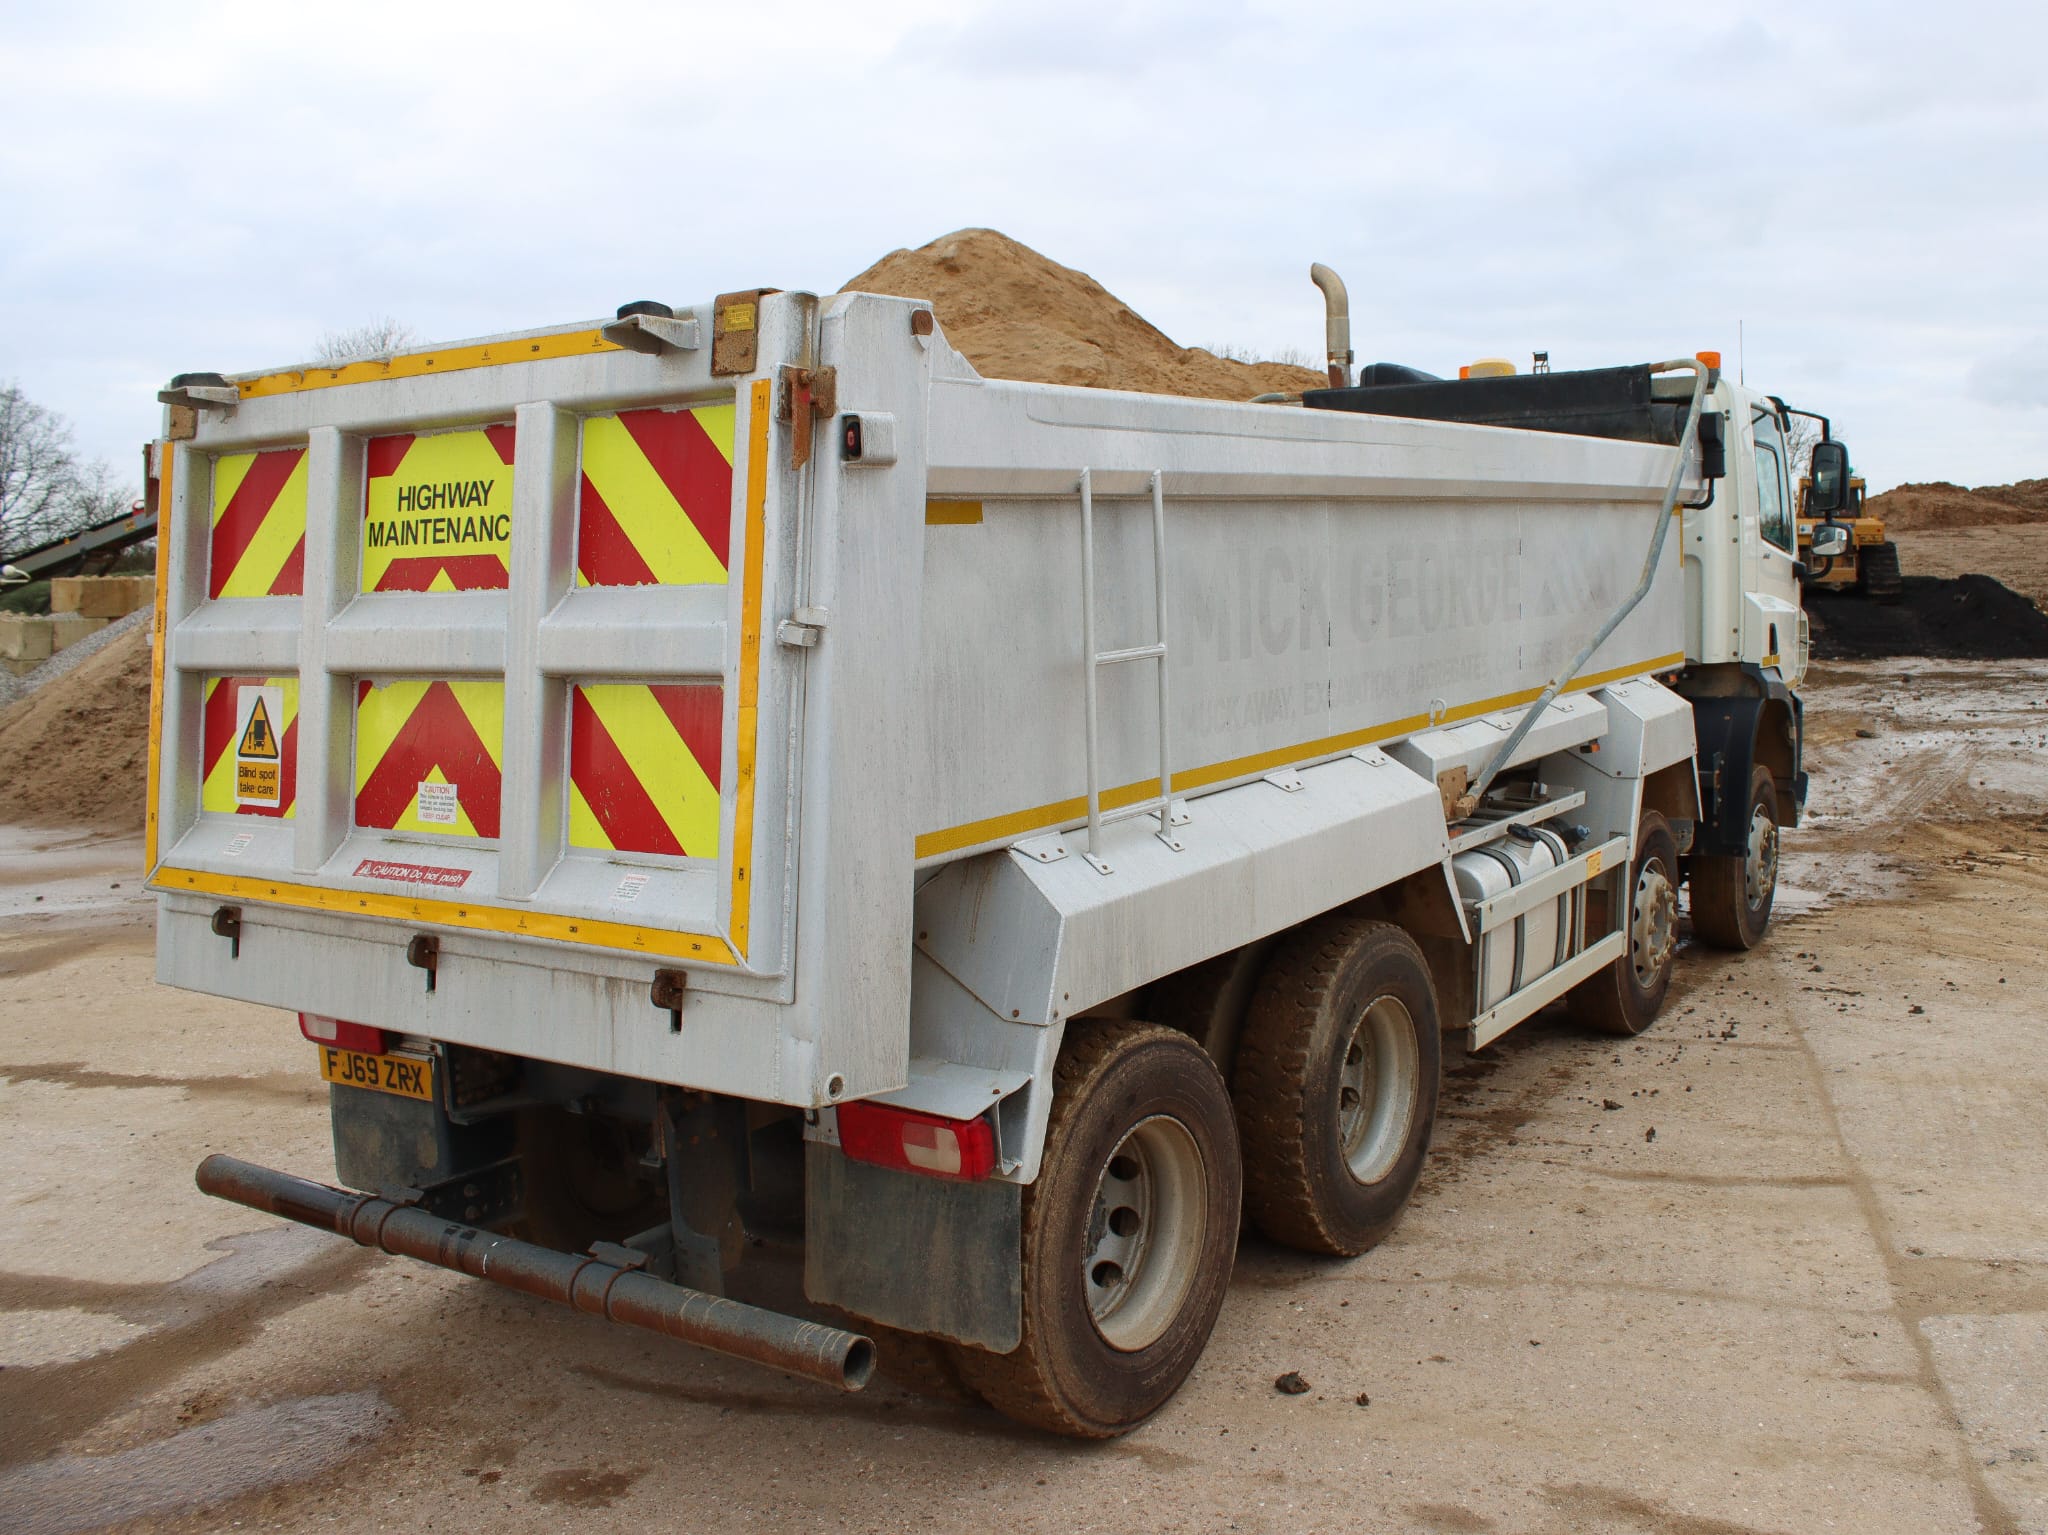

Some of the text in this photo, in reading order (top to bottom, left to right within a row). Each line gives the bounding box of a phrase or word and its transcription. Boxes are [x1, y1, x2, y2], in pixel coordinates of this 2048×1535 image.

[397, 479, 495, 512] HIGHWAY
[368, 514, 511, 547] MAINTENANC
[1179, 539, 1522, 667] MICK GEORGE
[239, 766, 276, 781] Blind spot
[239, 781, 274, 795] take care
[425, 786, 449, 794] CAUTION
[372, 864, 463, 883] CAUTION Do not push
[327, 1050, 424, 1095] FJ69 ZRX
